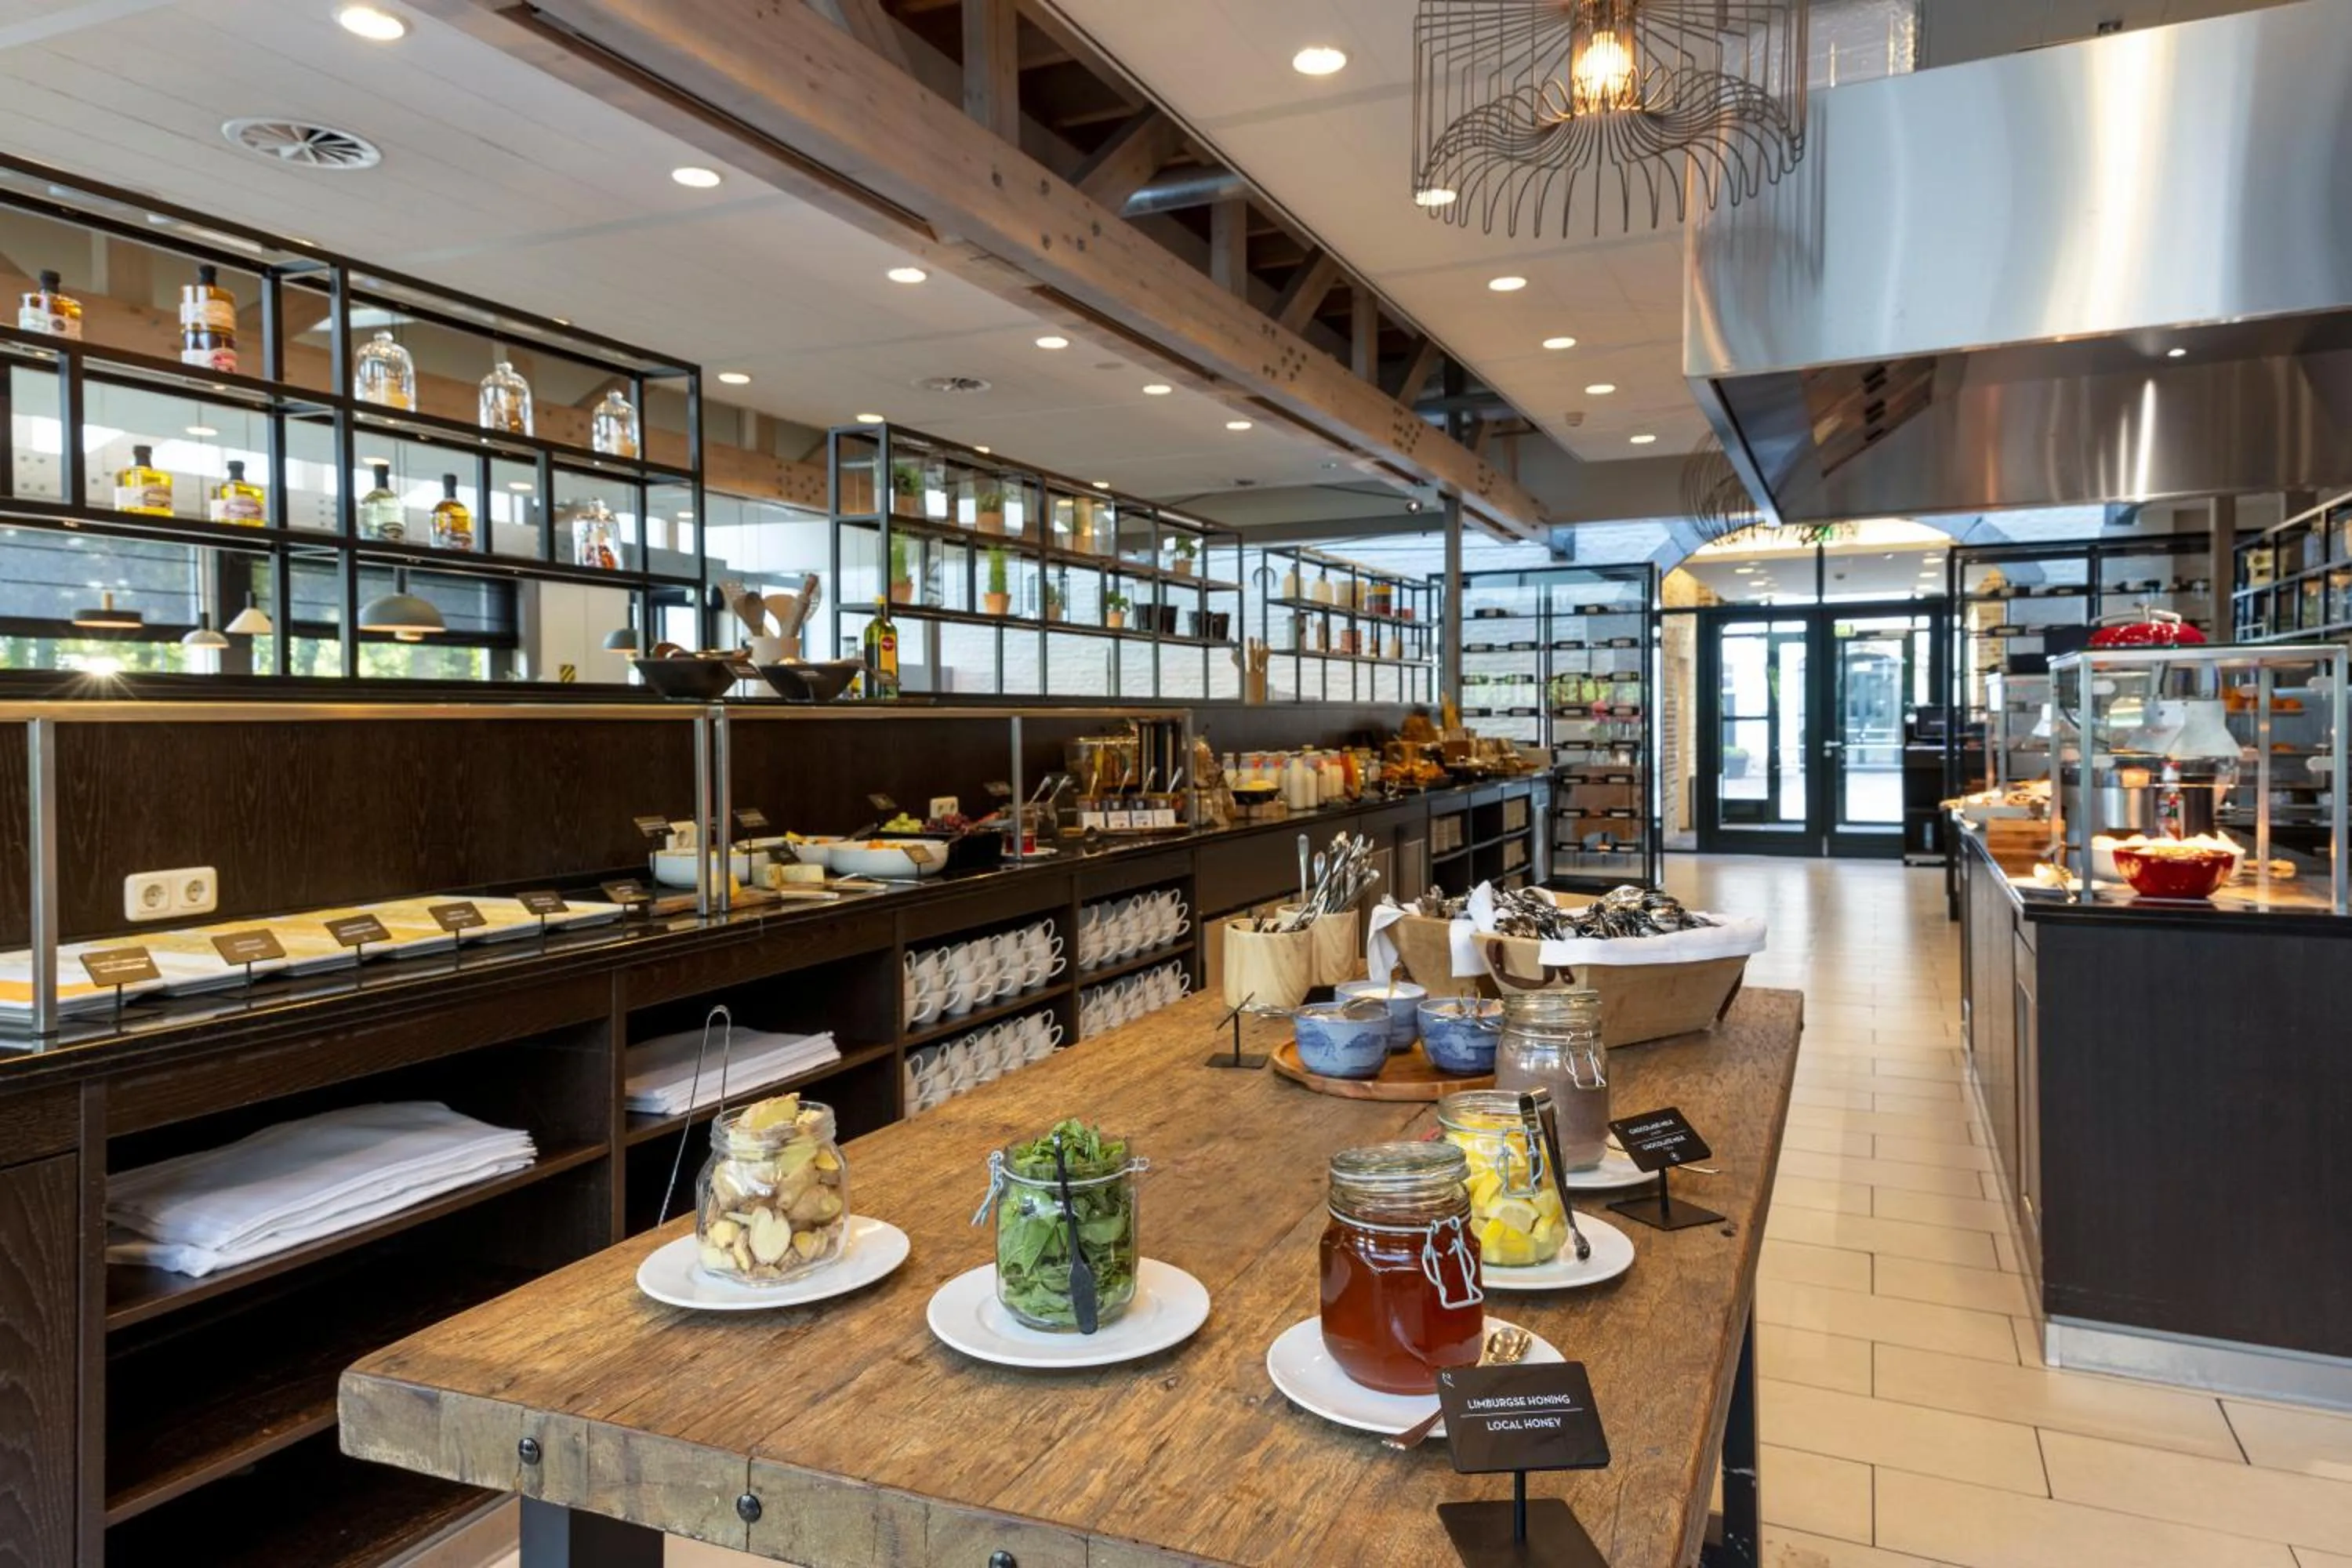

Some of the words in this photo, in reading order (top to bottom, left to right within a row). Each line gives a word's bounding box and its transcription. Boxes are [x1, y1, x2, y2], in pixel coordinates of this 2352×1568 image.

[1467, 1396, 1526, 1410] LIMBURGSE
[1526, 1394, 1570, 1406] HONING
[1486, 1420, 1523, 1431] LOCAL
[1523, 1417, 1561, 1429] HONEY
